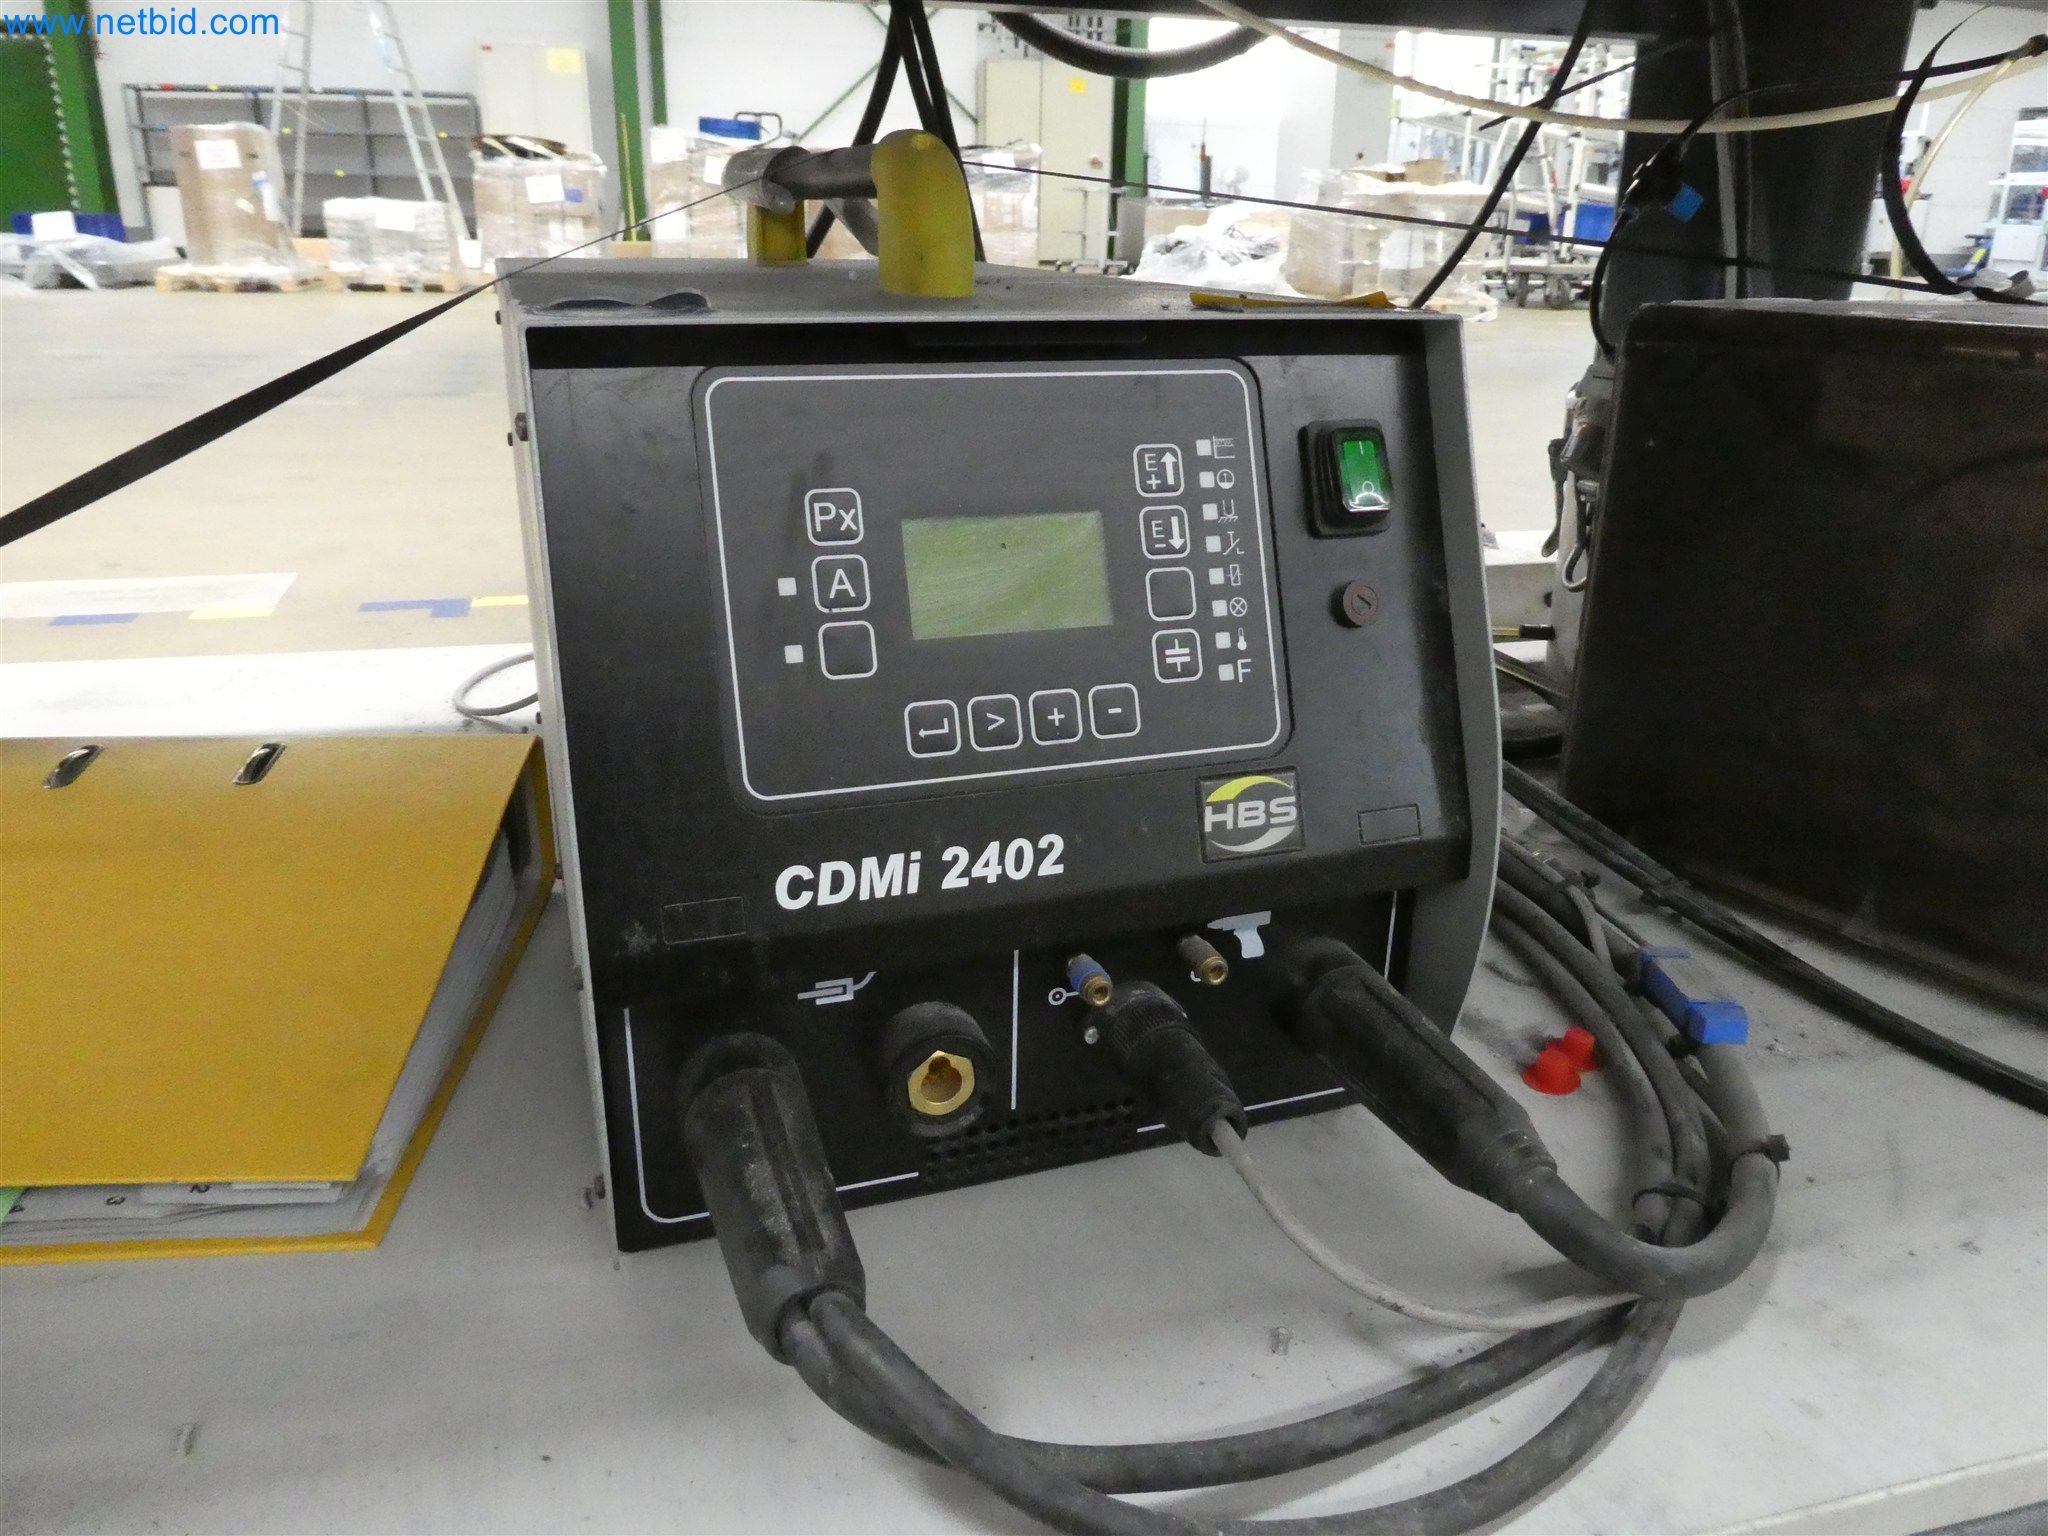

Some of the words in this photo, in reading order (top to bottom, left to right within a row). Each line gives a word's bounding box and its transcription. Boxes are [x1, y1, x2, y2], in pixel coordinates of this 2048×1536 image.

[813, 502, 858, 532] Px
[829, 568, 856, 599] A
[1237, 658, 1252, 683] F
[1203, 795, 1298, 834] HBS
[774, 850, 922, 911] CDMi
[941, 833, 1065, 890] 2402
